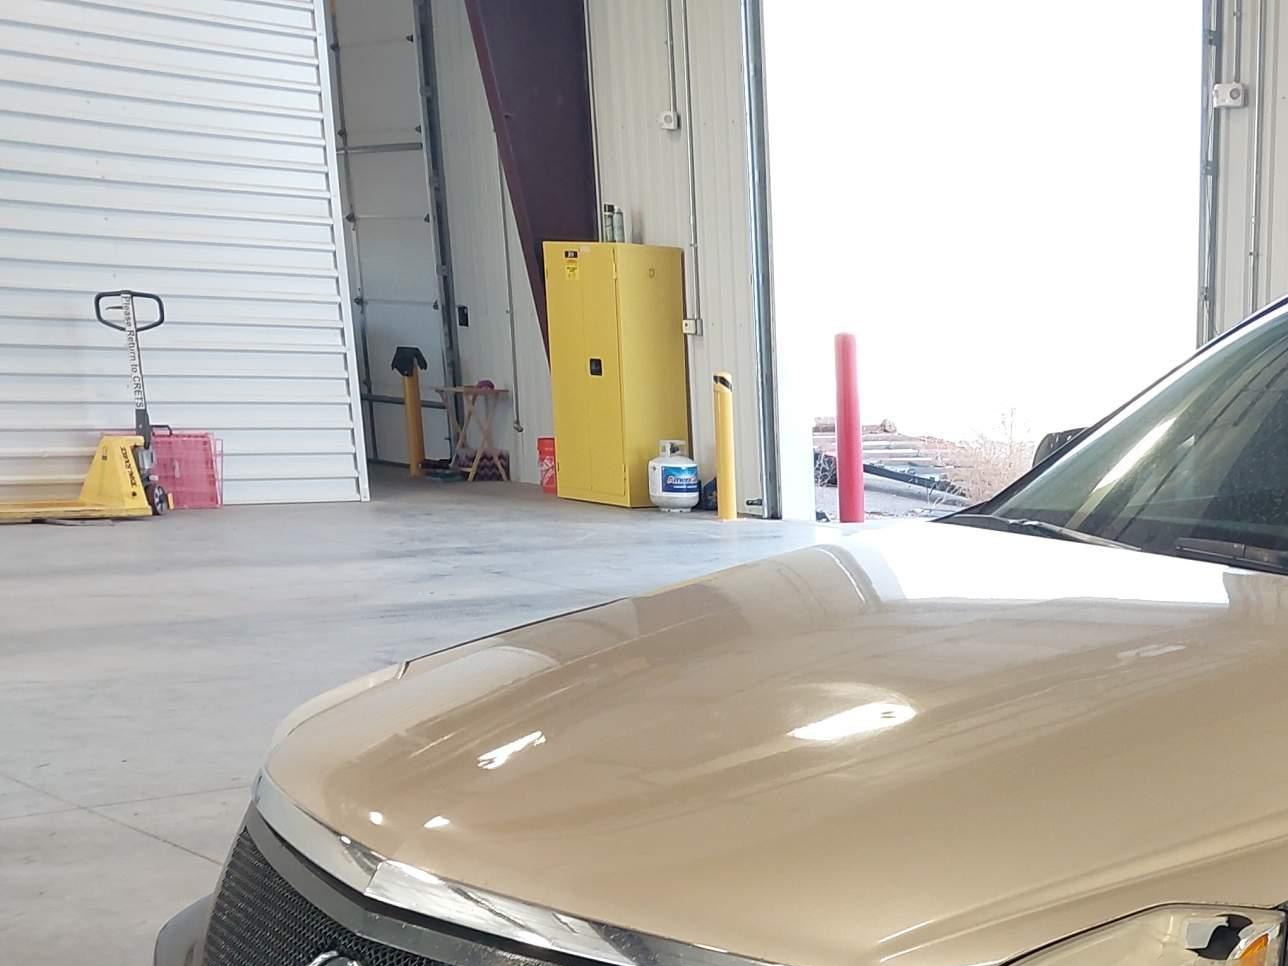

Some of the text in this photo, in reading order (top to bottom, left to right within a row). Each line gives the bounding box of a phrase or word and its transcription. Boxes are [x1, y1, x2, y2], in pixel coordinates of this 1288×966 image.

[127, 330, 137, 362] Return
[130, 363, 138, 374] to
[132, 376, 144, 408] CRETS
